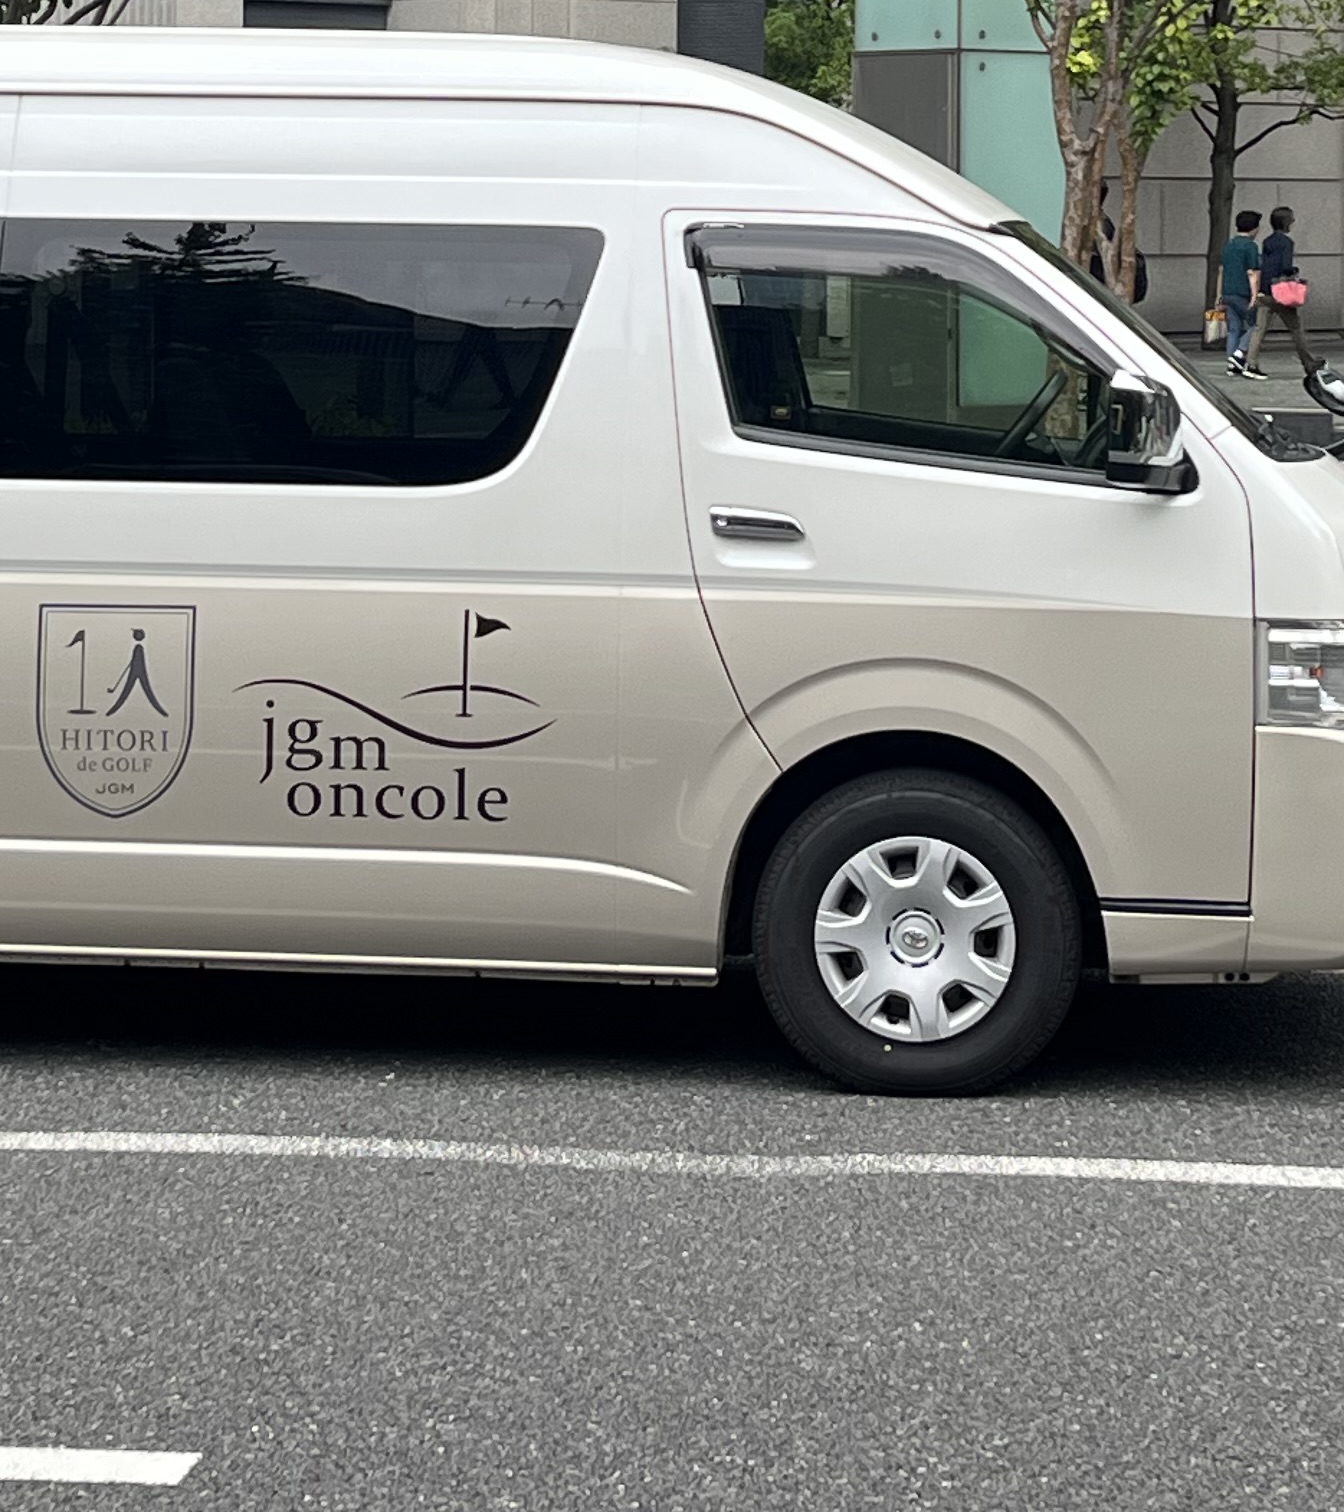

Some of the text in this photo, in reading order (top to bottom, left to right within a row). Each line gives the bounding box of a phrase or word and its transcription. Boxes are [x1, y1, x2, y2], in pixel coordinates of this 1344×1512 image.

[60, 728, 169, 752] HITORI
[259, 700, 390, 784] jgm
[77, 756, 153, 773] de GOLF
[95, 783, 135, 795] JGM
[286, 767, 509, 822] oncole
